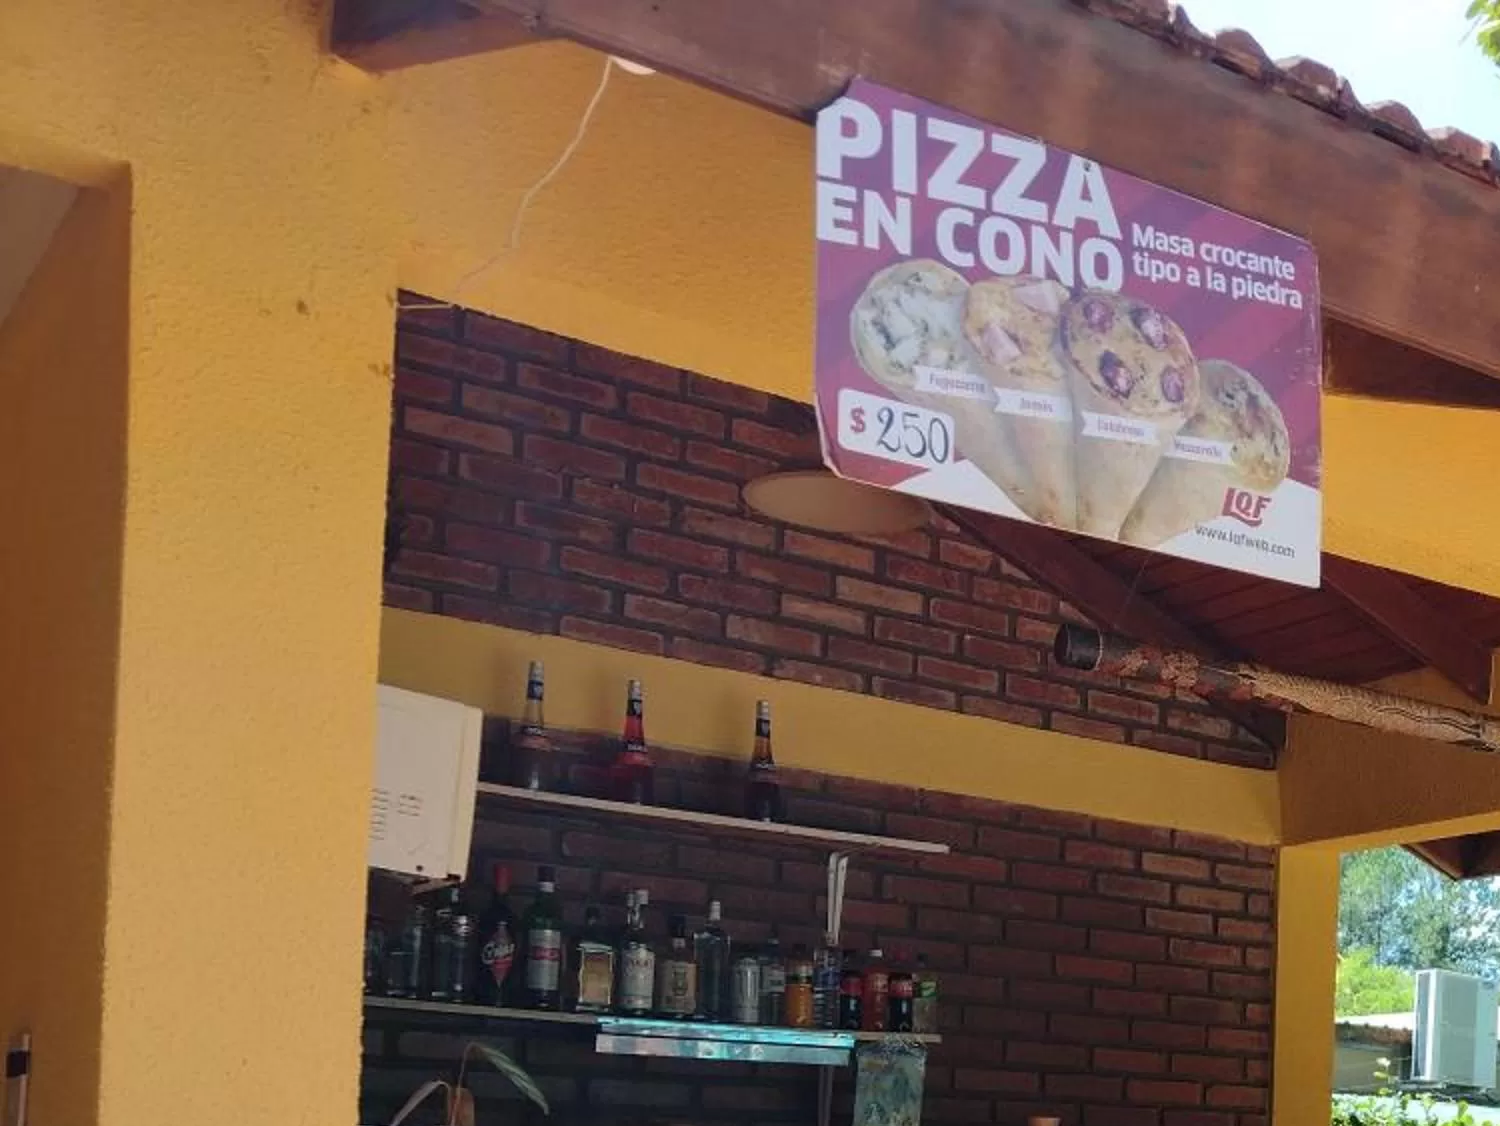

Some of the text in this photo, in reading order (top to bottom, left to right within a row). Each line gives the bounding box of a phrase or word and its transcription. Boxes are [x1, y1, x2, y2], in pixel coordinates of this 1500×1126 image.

[815, 96, 1122, 240] PIZZA
[815, 180, 1124, 294] EN CONO
[1131, 223, 1295, 281] Masa crocante
[1132, 252, 1303, 310] tipo a la piedra
[849, 405, 949, 464] $ 250
[1222, 486, 1273, 528] LQF
[1195, 523, 1296, 559] www.lqfweb.com
